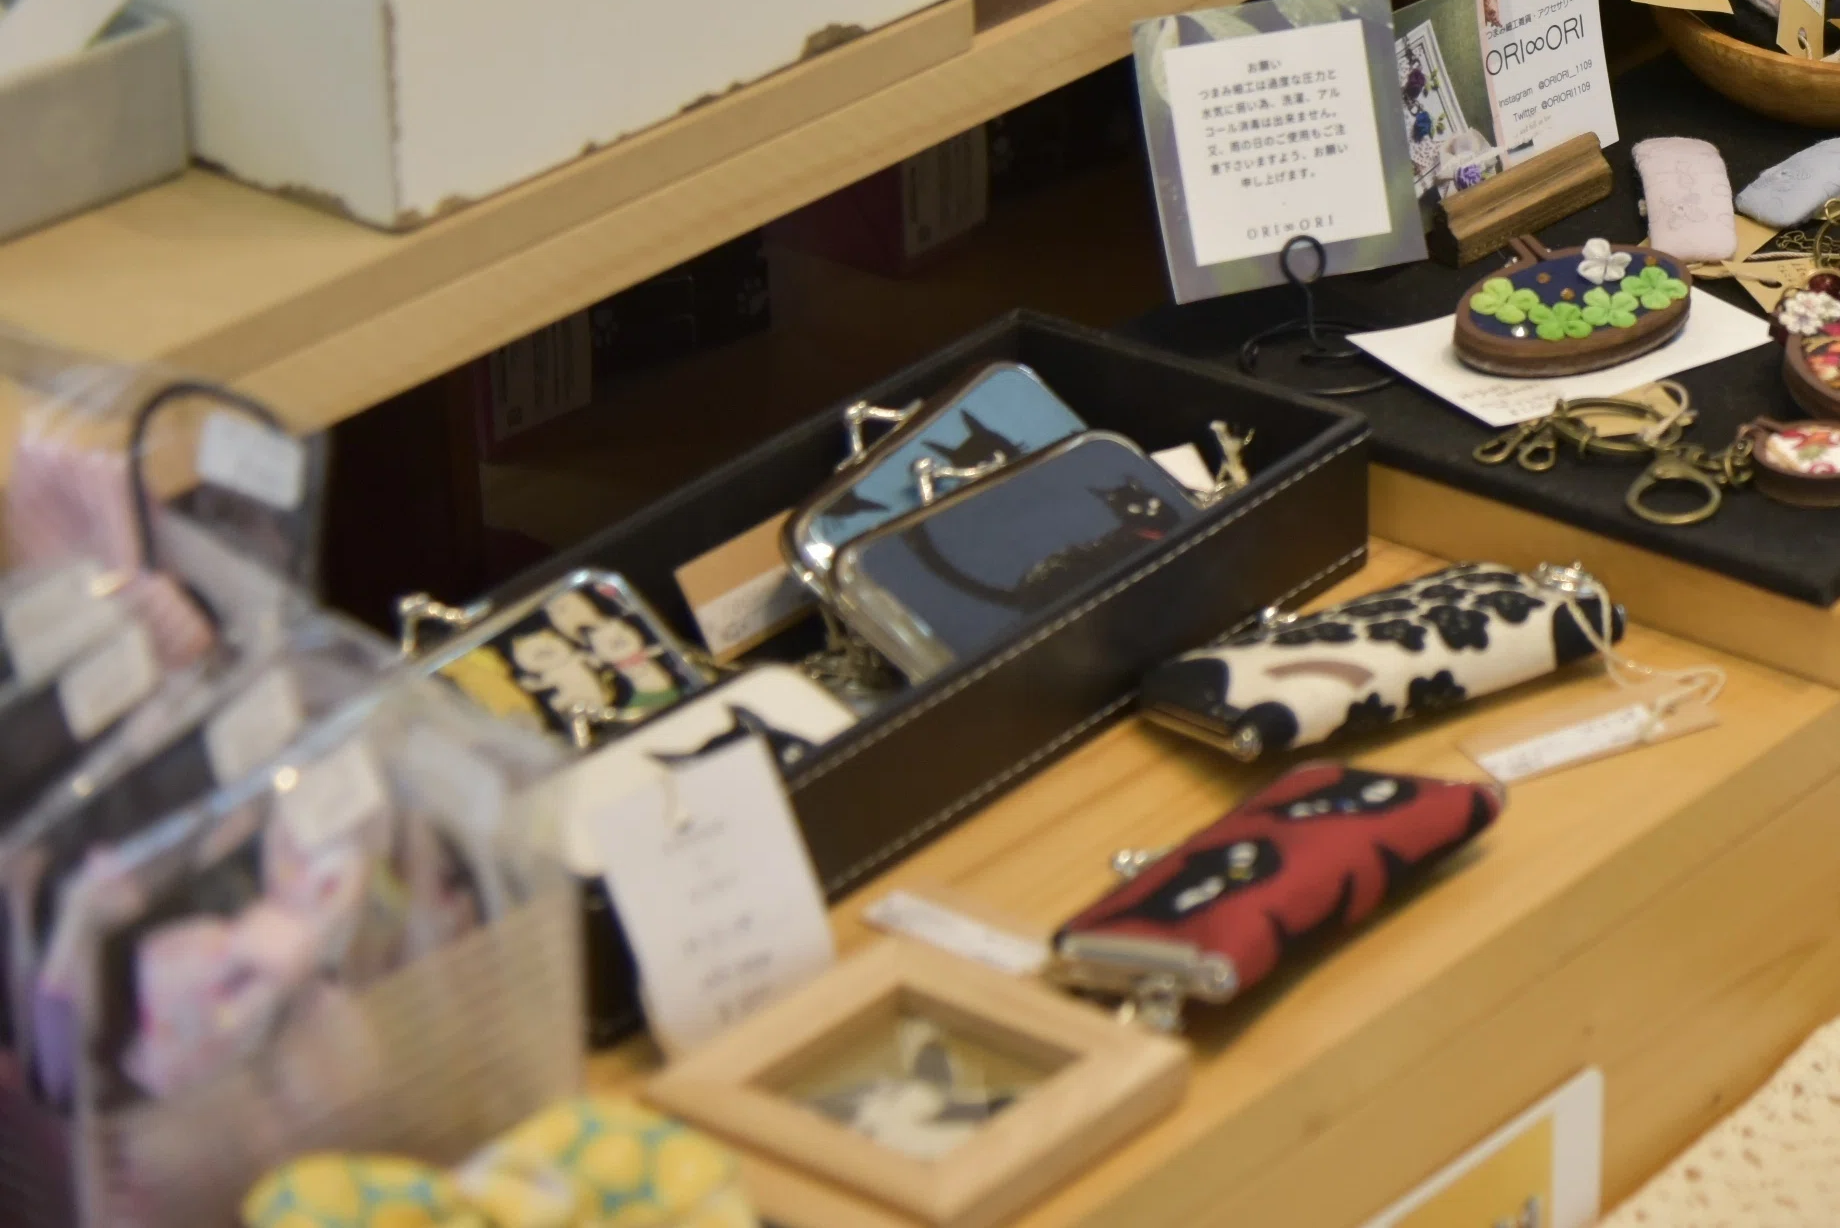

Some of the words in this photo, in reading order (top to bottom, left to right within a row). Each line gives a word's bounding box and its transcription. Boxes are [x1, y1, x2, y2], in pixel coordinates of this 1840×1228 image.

[1247, 59, 1283, 74] お願い
[1498, 87, 1534, 108] Instagram
[1513, 105, 1538, 123] Twitter
